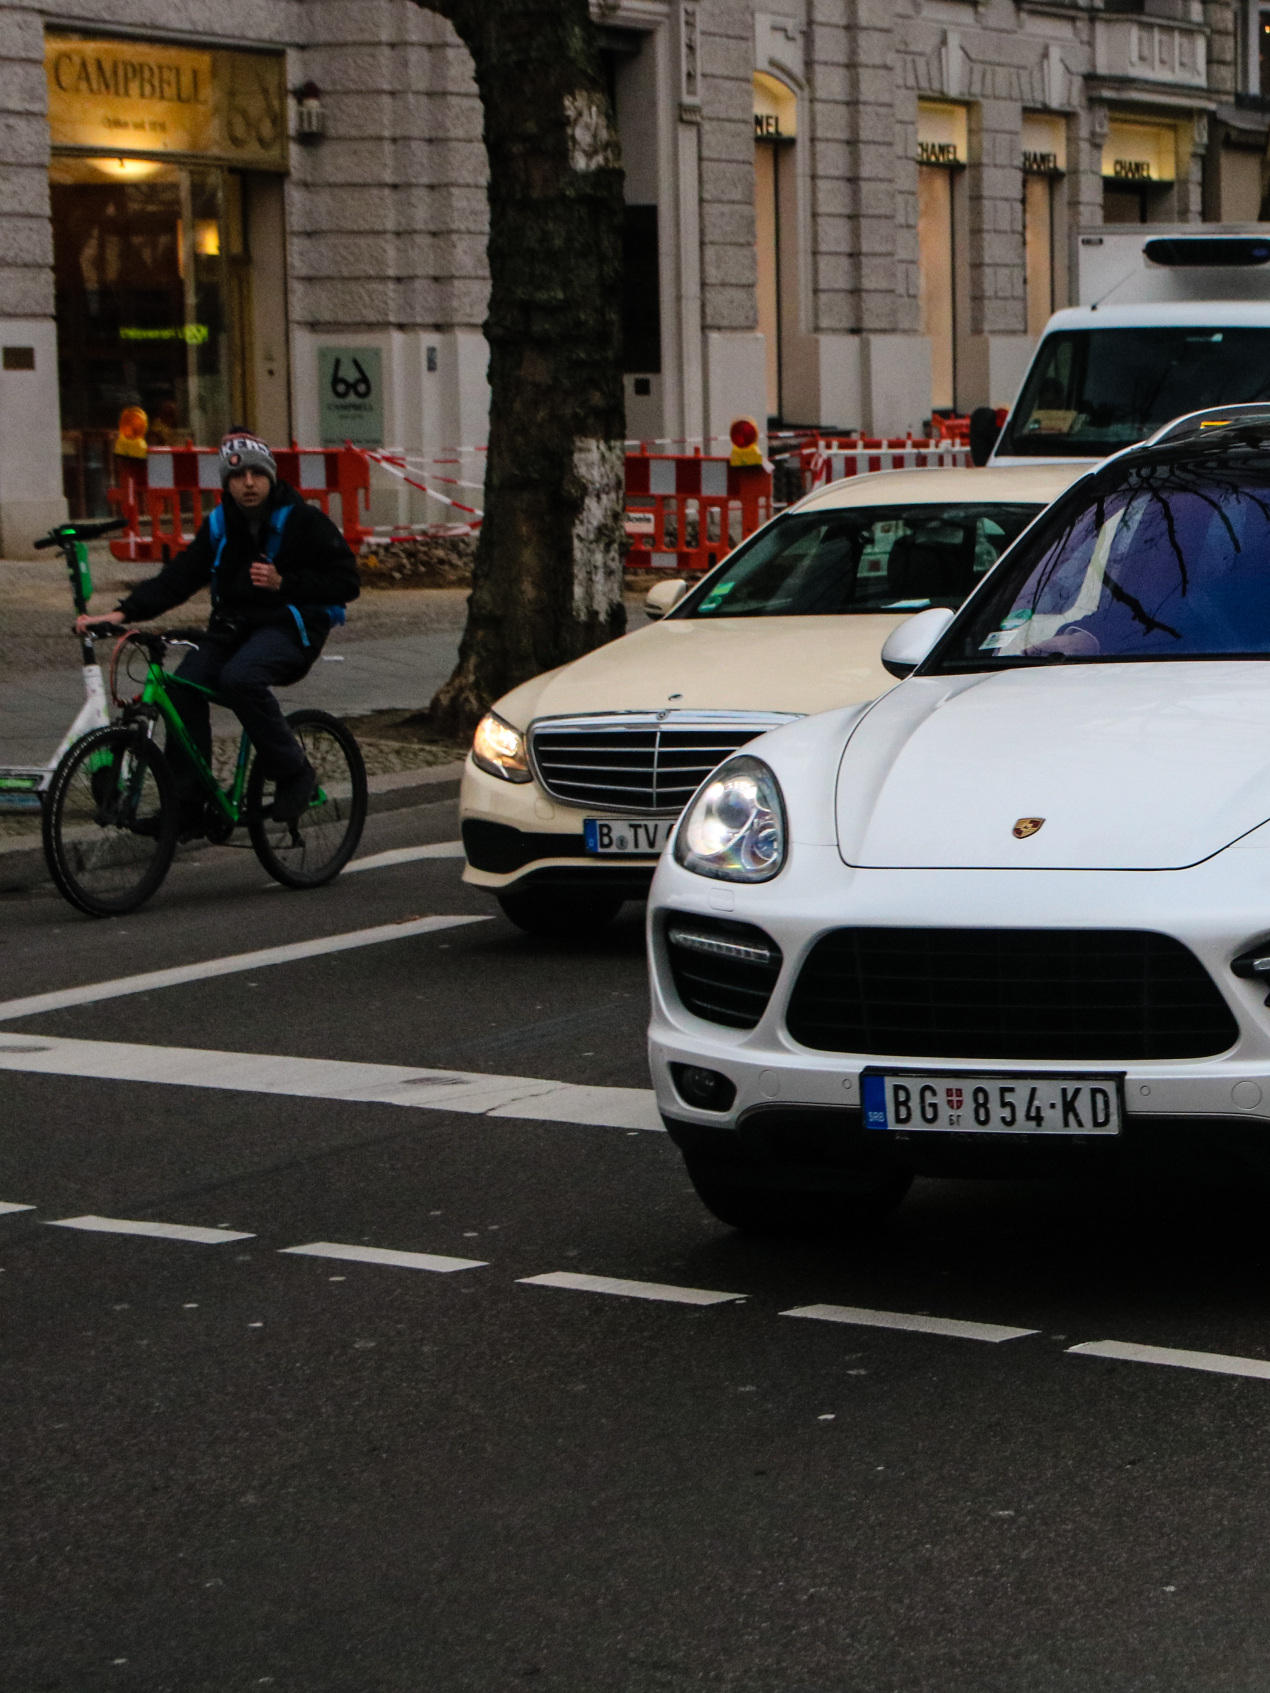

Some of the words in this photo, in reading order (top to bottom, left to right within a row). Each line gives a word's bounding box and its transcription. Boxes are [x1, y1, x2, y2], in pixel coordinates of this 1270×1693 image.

[54, 52, 207, 104] CAMPBELL
[1114, 159, 1152, 179] CHANEL
[598, 823, 613, 849] B
[628, 823, 658, 849] TV
[868, 1111, 885, 1122] SRB
[892, 1083, 939, 1125] BG
